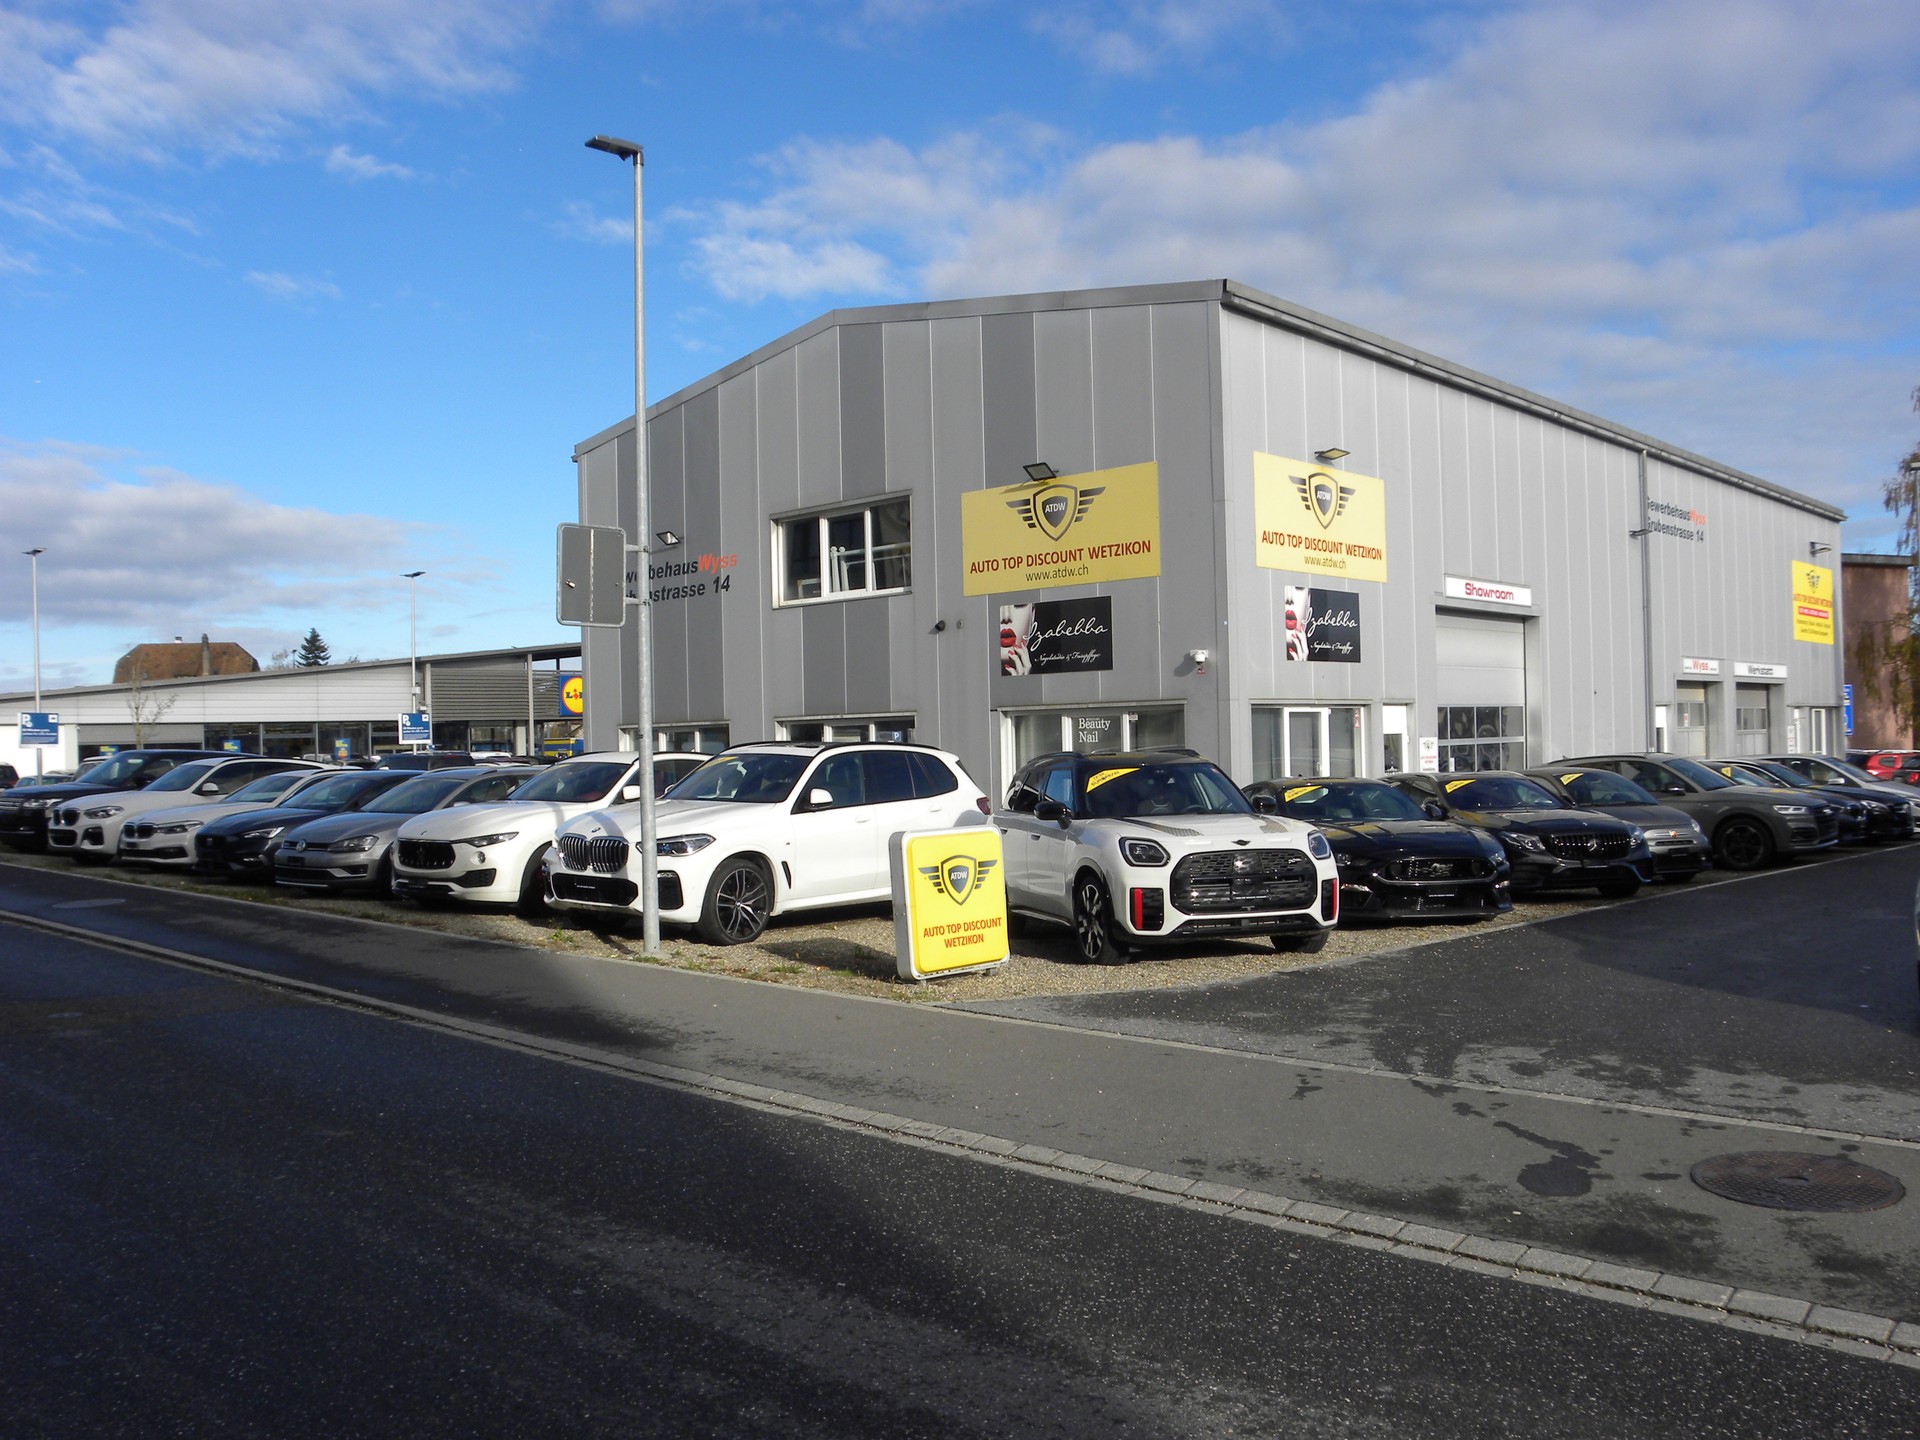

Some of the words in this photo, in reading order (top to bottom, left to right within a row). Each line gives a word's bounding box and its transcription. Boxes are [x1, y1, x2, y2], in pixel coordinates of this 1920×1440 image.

[1044, 501, 1066, 514] ATDW
[1695, 529, 1704, 543] 14
[1261, 530, 1286, 546] AUTO
[1287, 533, 1303, 549] TOP
[1304, 535, 1343, 555] DISCOUNT
[1345, 543, 1382, 561] WETZIKON
[969, 558, 999, 575] AUTO
[1002, 556, 1023, 570] TOP
[1026, 548, 1084, 567] DISCOUNT
[1087, 540, 1152, 560] WETZIKON
[1304, 555, 1347, 570] www.atdw.ch
[1025, 564, 1089, 582] www.atdw.ch
[712, 574, 731, 594] 14
[1464, 582, 1514, 601] Showroom
[1078, 717, 1111, 731] Beauty
[1078, 731, 1099, 743] Nail
[950, 870, 967, 880] ATDW
[923, 925, 945, 939] AUTO
[946, 922, 962, 935] TOP
[963, 917, 1002, 932] DISCOUNT
[944, 934, 985, 949] WETZIKON
